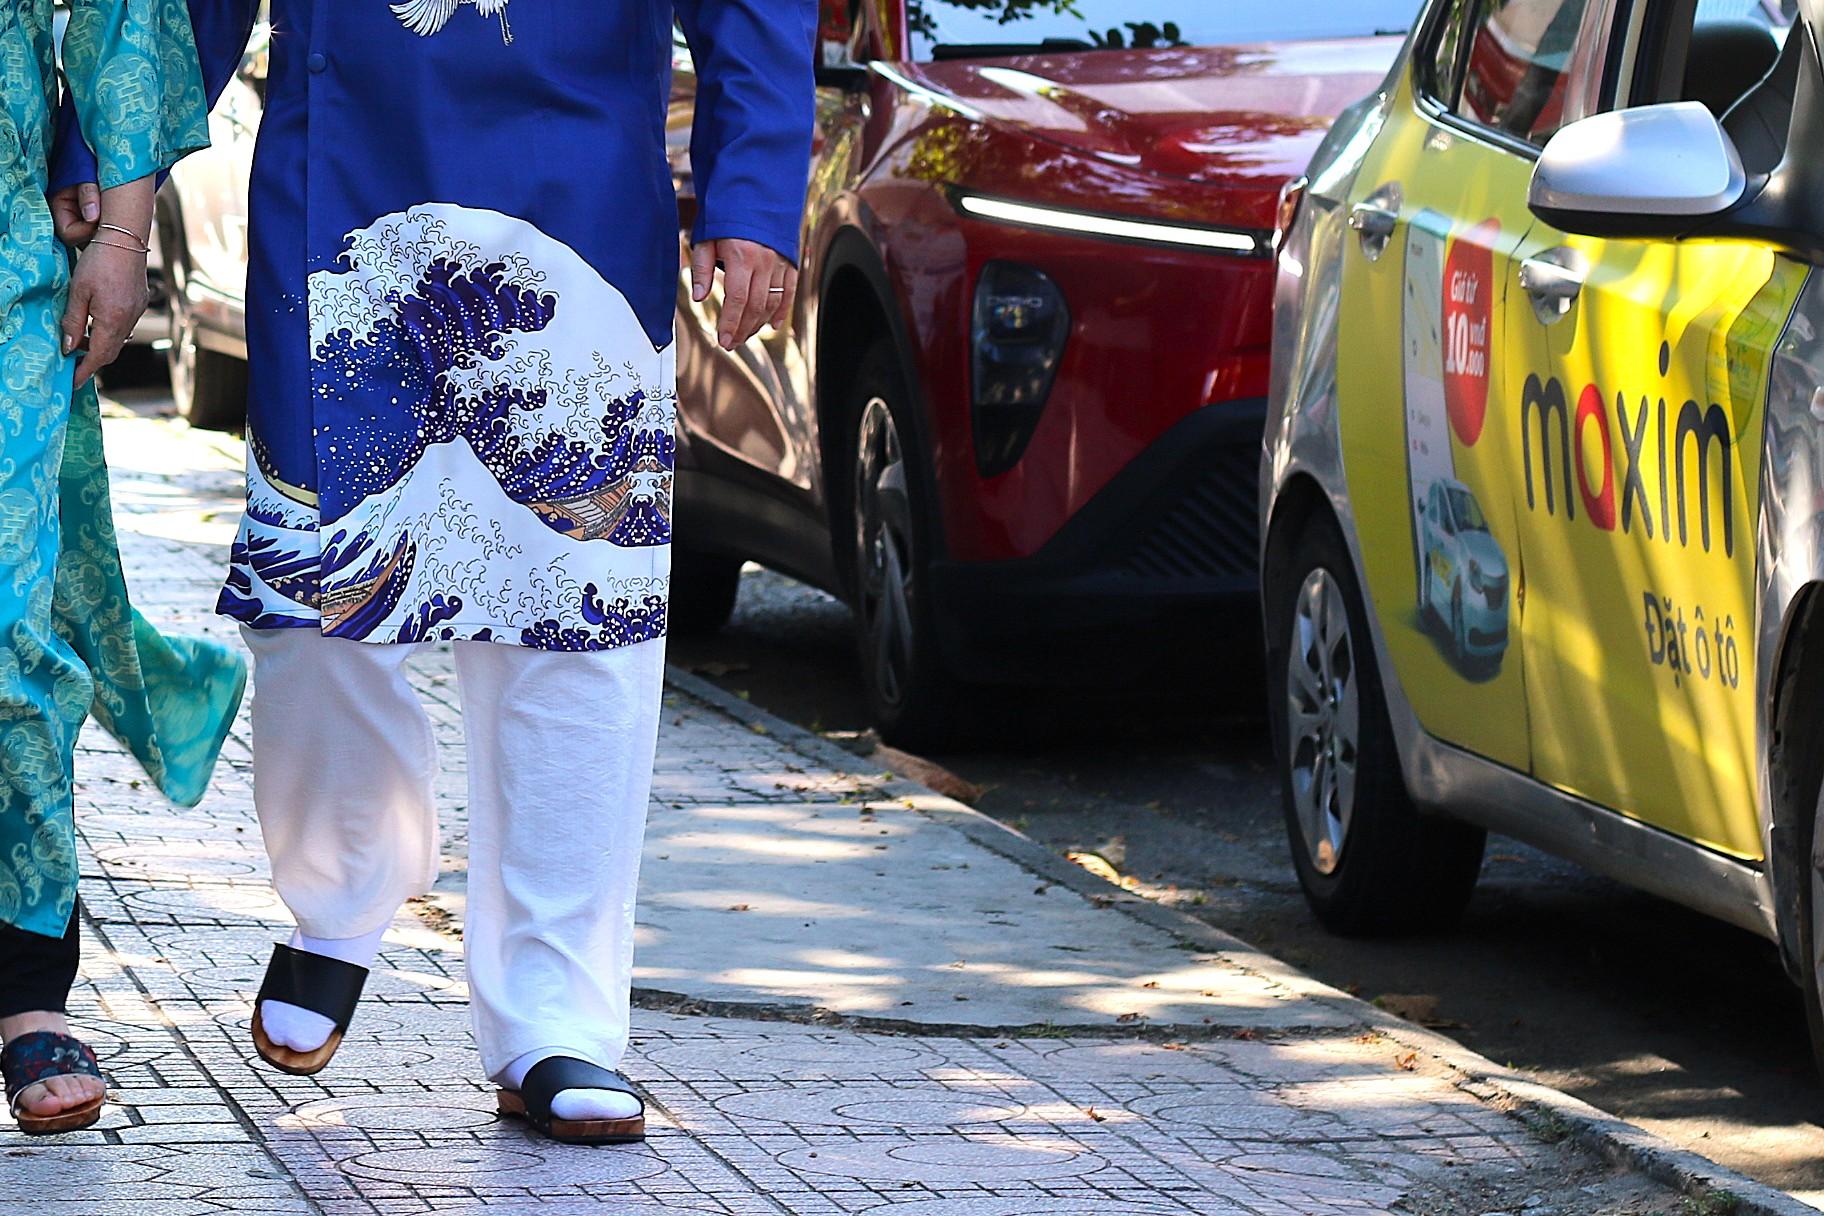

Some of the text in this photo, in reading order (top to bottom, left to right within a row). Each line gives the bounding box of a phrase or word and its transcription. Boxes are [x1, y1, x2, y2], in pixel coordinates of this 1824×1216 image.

[1451, 270, 1467, 303] Giá
[1522, 340, 1734, 560] maxim
[1644, 591, 1739, 690] Đặt ô tô
